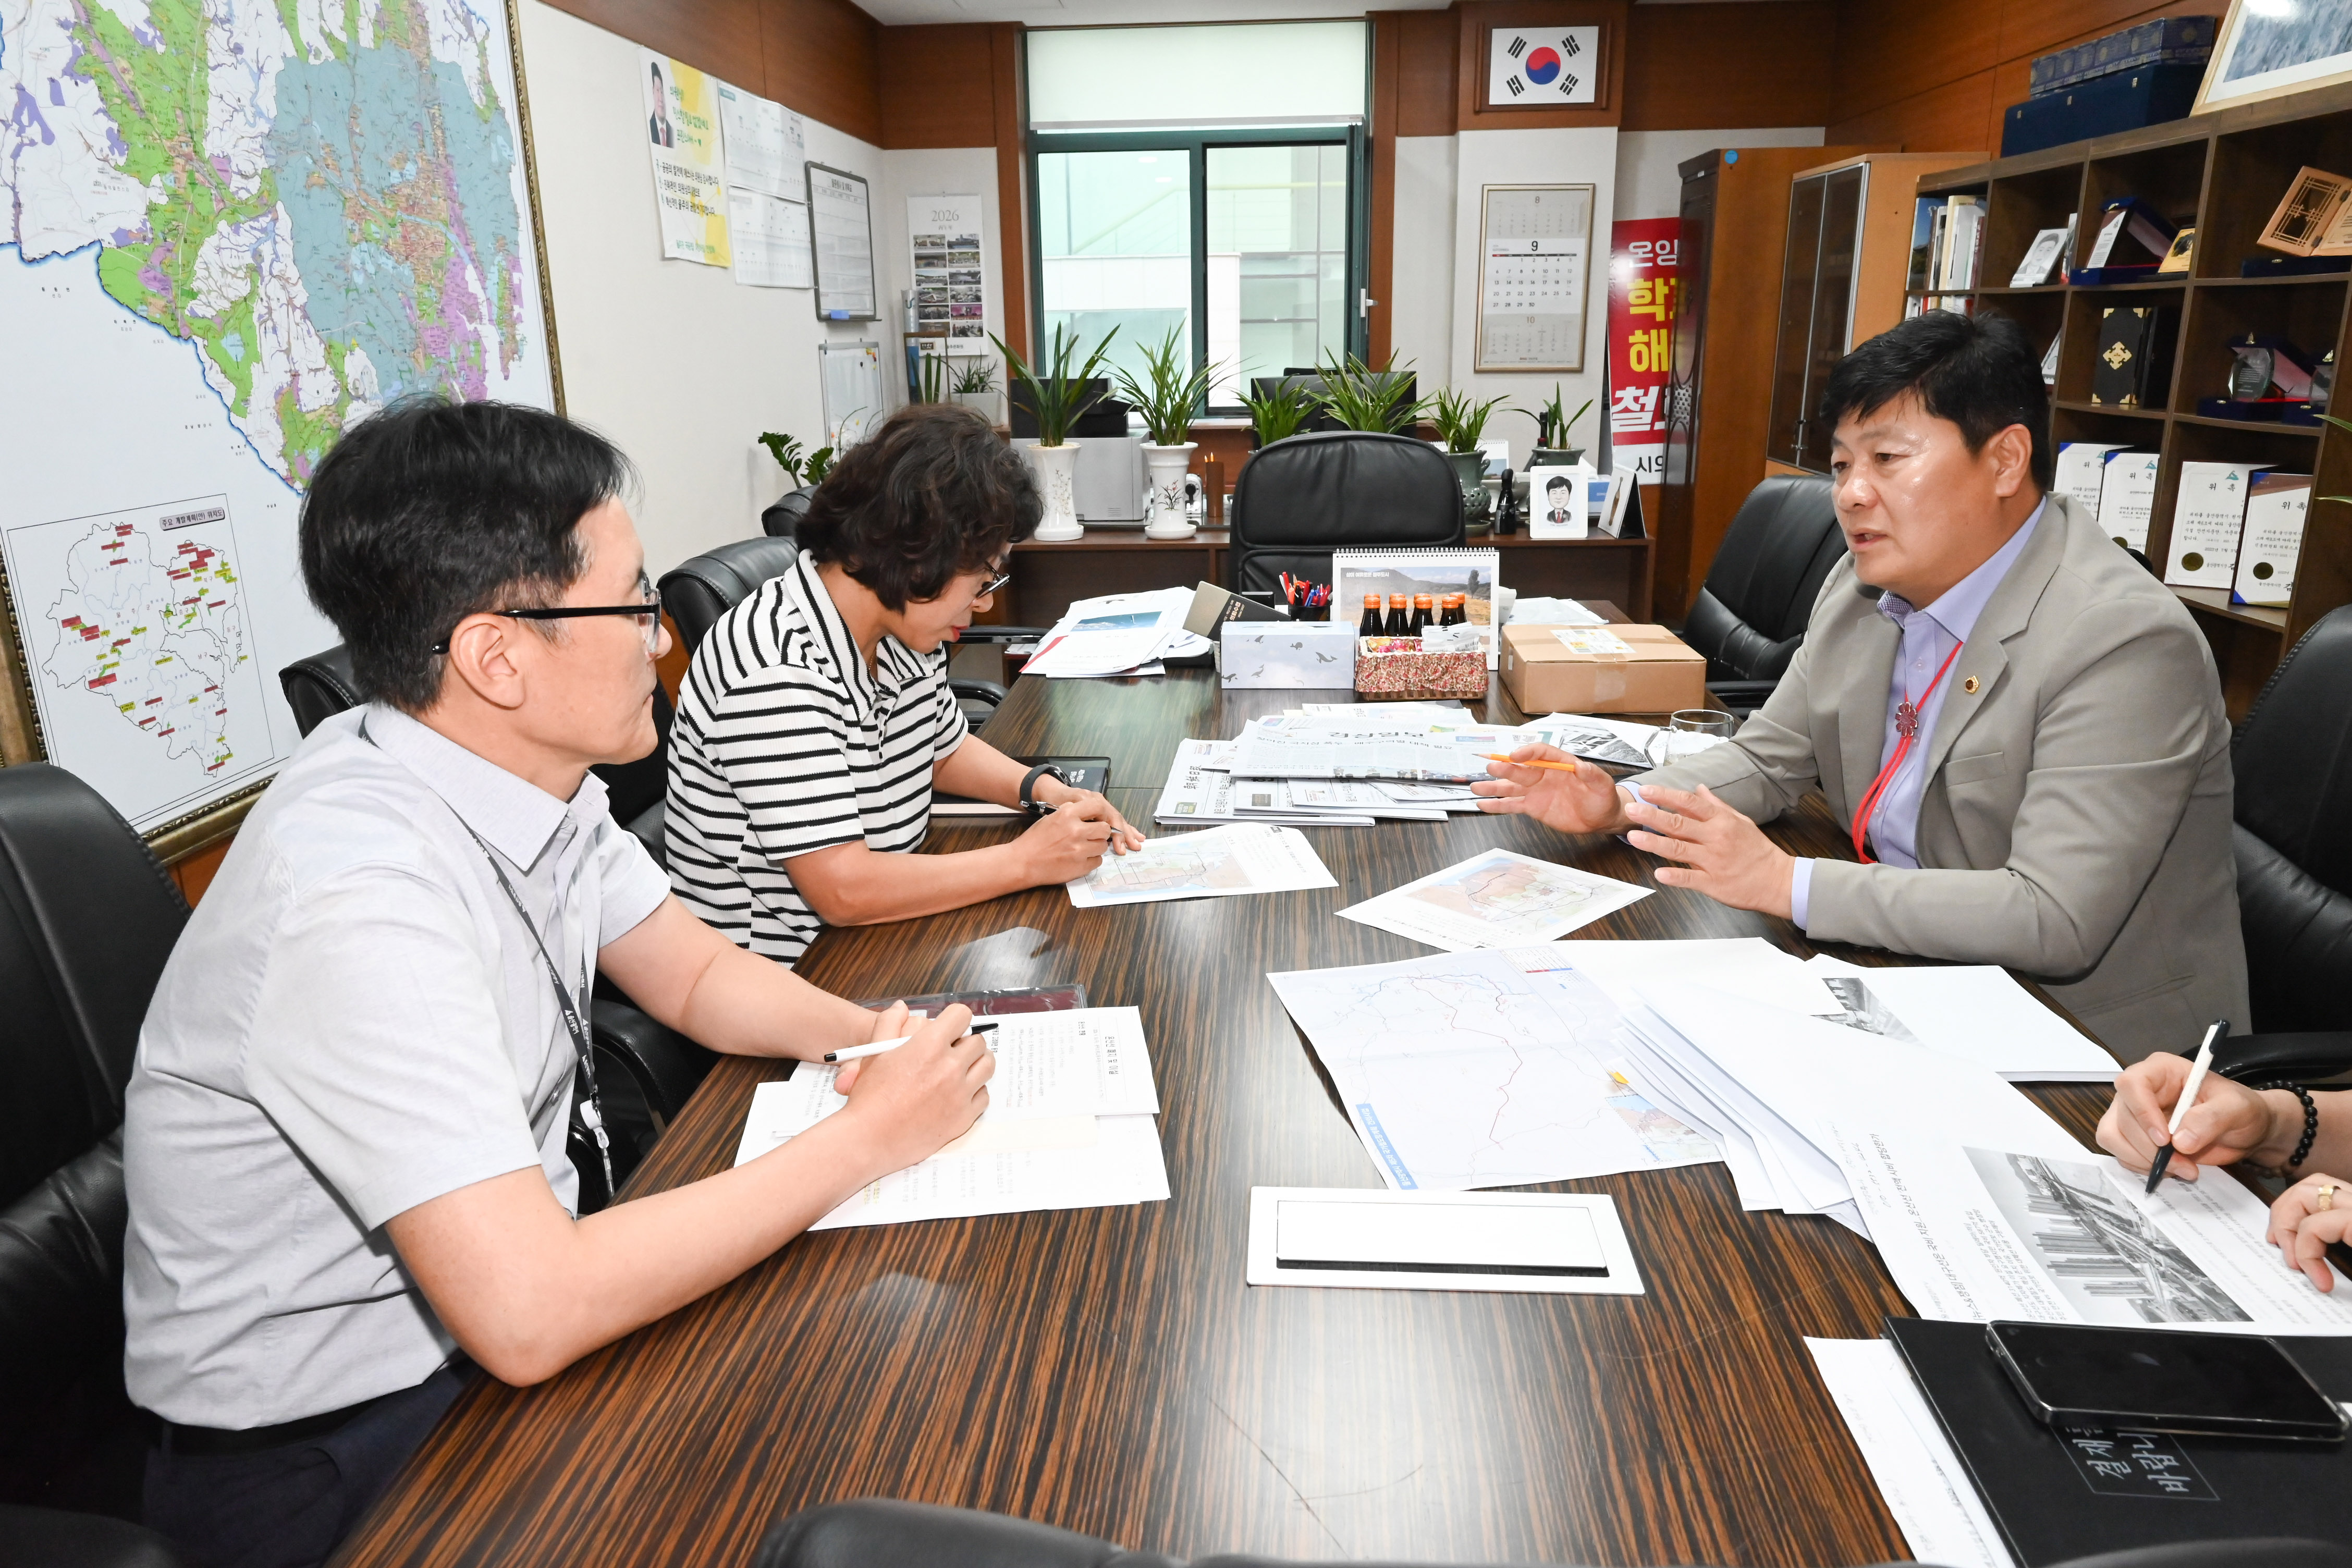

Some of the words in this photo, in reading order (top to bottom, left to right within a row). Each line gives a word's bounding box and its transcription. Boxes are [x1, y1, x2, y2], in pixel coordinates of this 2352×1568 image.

[932, 210, 959, 222] 2026
[1532, 241, 1538, 251] 9
[1627, 278, 1675, 322] 학
[1628, 328, 1669, 372] 해
[2209, 483, 2217, 491] 위
[2227, 483, 2236, 492] 촉
[2282, 501, 2290, 510] 위
[2296, 501, 2307, 511] 촉
[162, 519, 173, 527] 주요
[176, 512, 205, 524] 개발계획(안)
[207, 509, 223, 519] 위치도
[1229, 601, 1241, 621] 의회수첩
[1104, 1036, 1116, 1047] 온산선
[1106, 1049, 1117, 1057] 폐지
[1107, 1065, 1120, 1074] 이설
[1871, 1134, 1890, 1159] 합당한가
[1922, 1238, 1938, 1251] 국비
[1932, 1253, 1958, 1281] 대구선은
[2116, 1432, 2191, 1492] 바랍니
